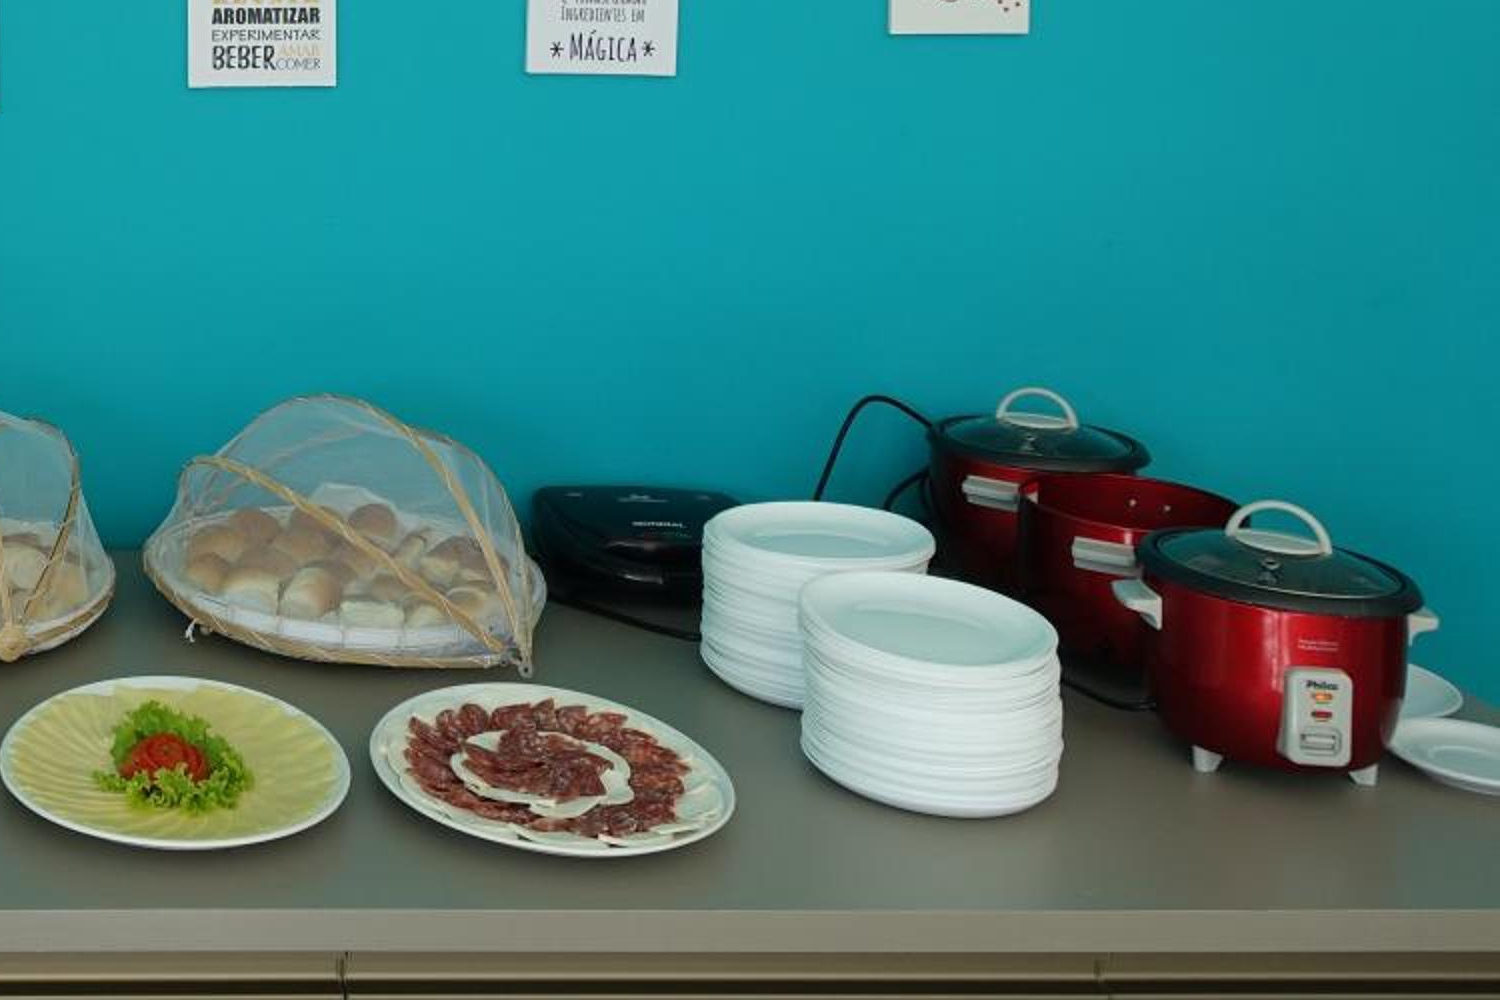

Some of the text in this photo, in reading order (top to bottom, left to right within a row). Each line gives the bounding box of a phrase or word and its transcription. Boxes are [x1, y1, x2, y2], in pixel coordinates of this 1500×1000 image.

[212, 8, 320, 25] AROMATIZAR
[561, 6, 645, 22] INGREDIENTES EM
[212, 29, 320, 42] EXPERIMENTAR
[570, 29, 637, 62] MÁGICA
[212, 45, 276, 70] BEBER
